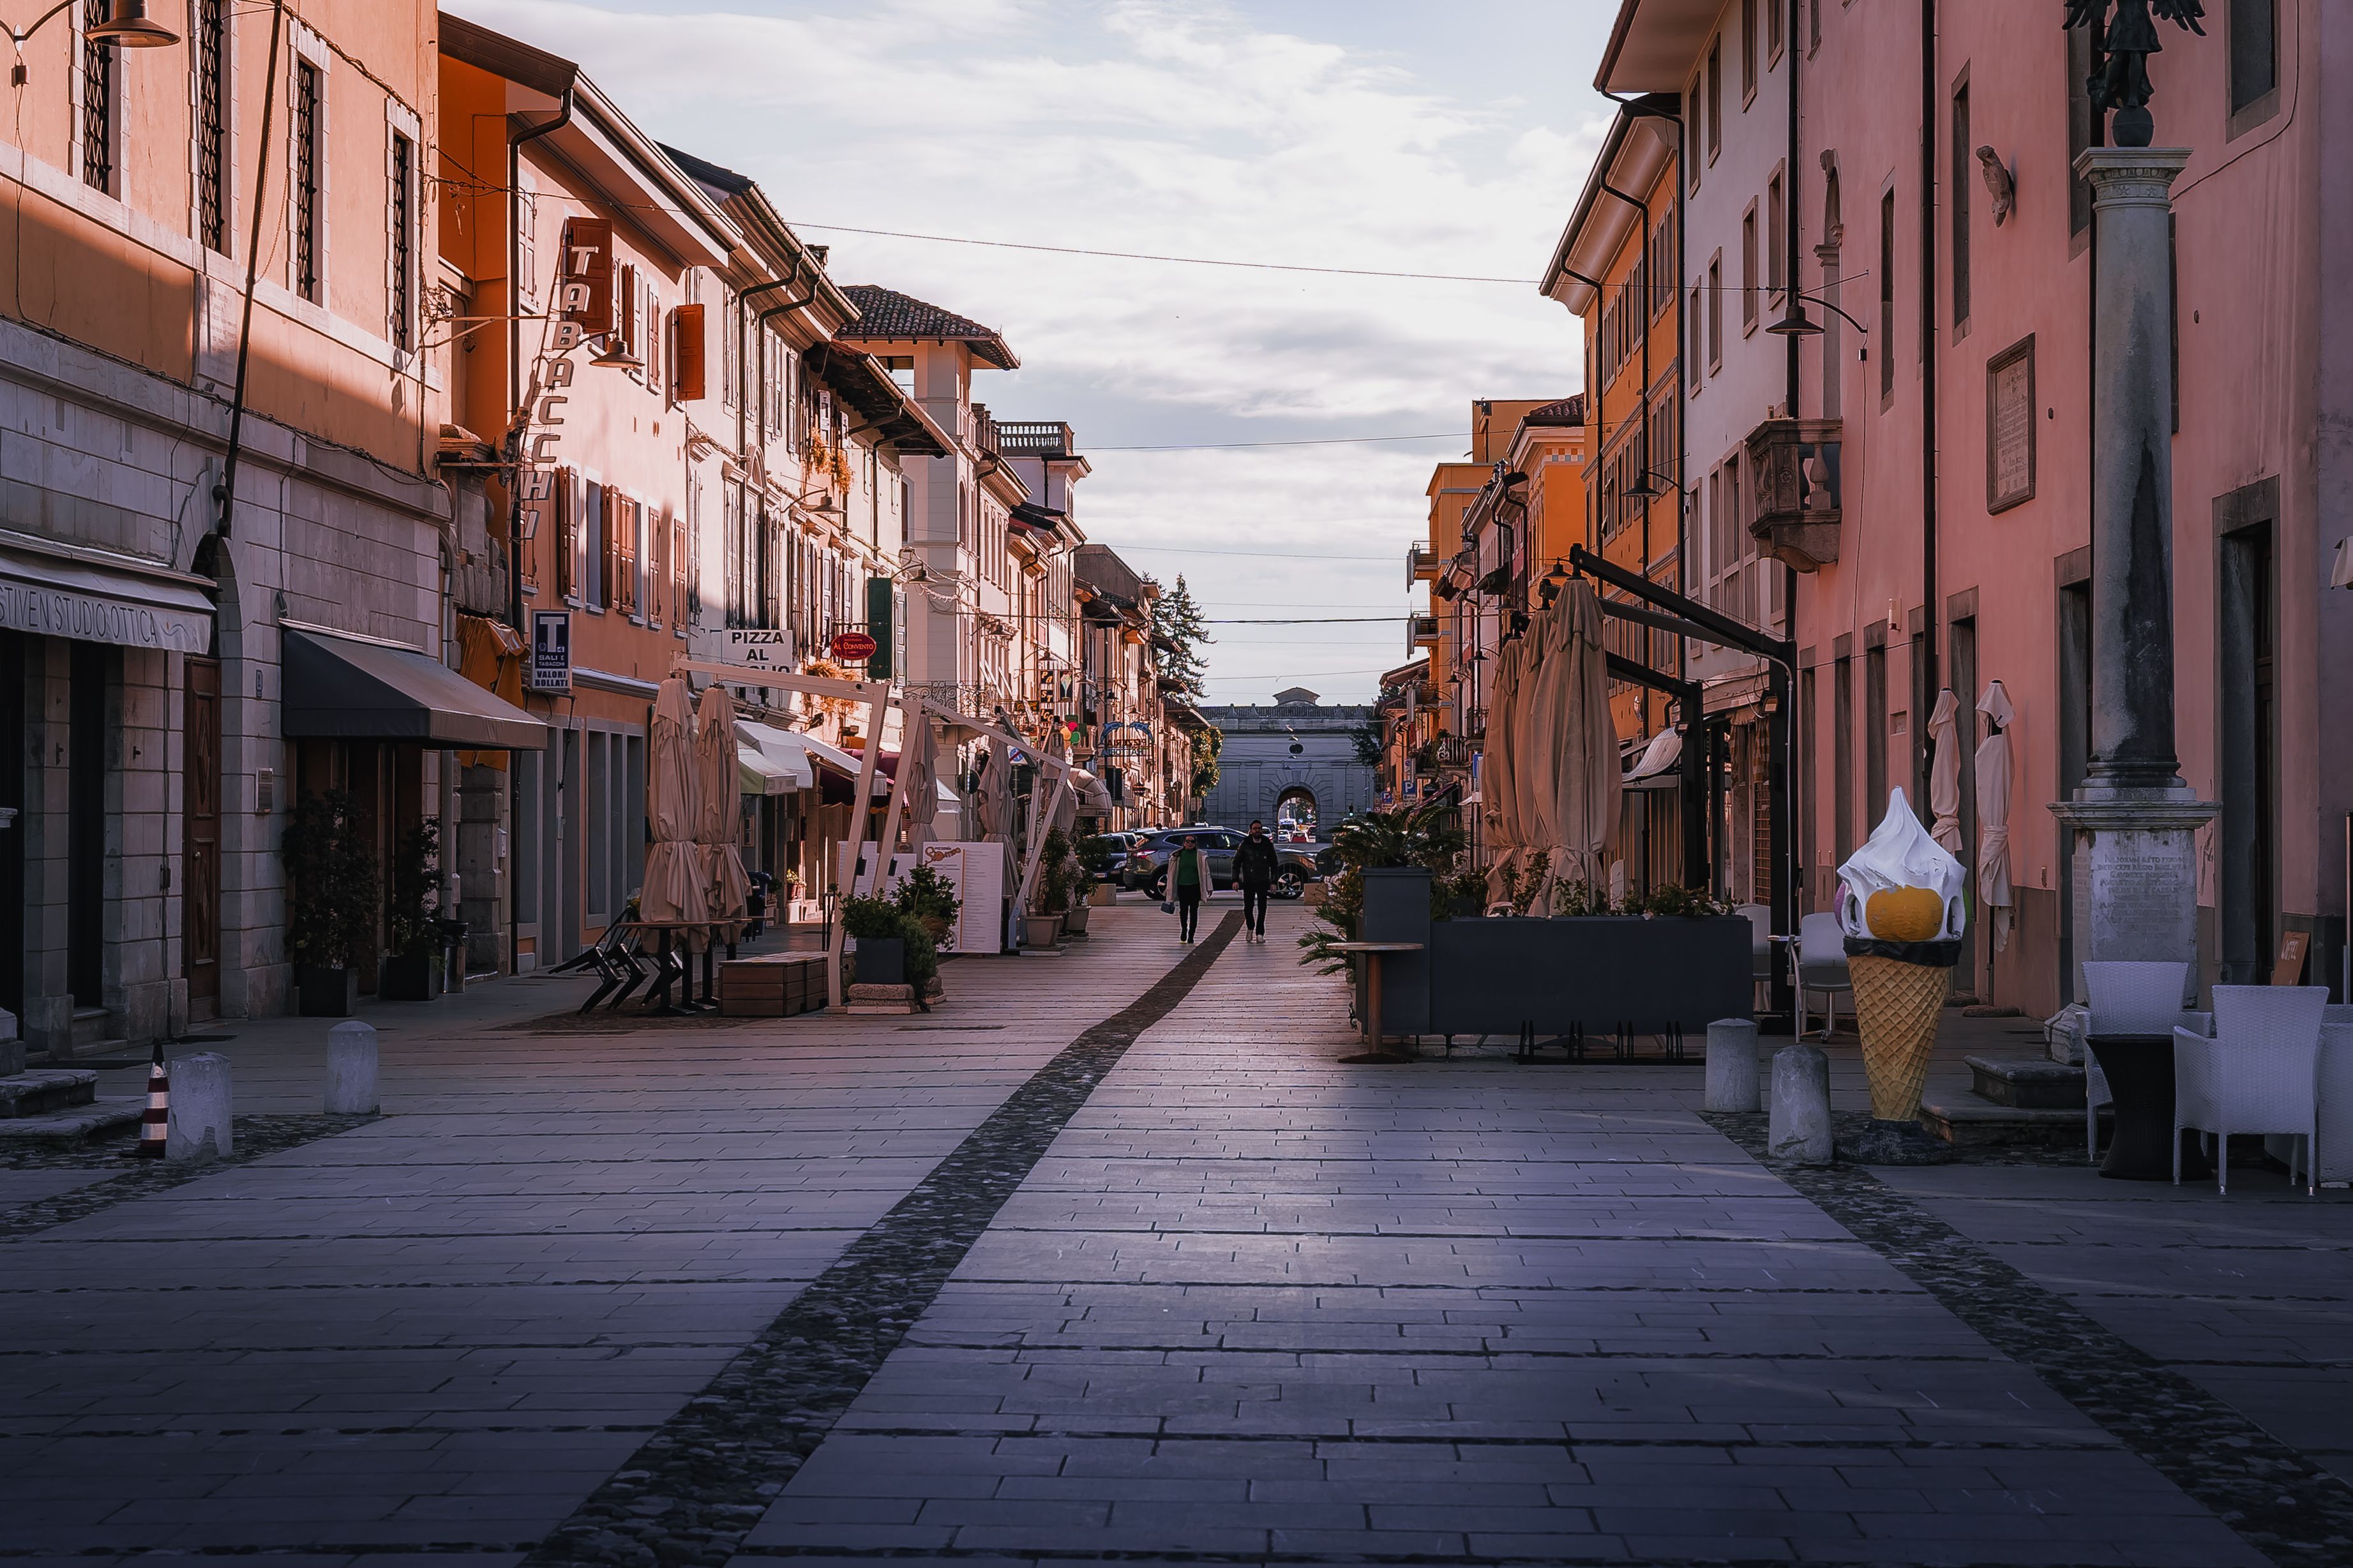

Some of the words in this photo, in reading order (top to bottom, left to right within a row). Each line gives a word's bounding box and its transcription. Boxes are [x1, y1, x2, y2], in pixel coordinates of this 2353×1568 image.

[522, 245, 599, 539] TABACCHI
[54, 595, 107, 637] STUDIO
[110, 606, 158, 643] OTTICA
[539, 616, 565, 652] T
[732, 632, 785, 644] PIZZA
[746, 648, 769, 661] AL
[535, 679, 568, 687] BOLLATI
